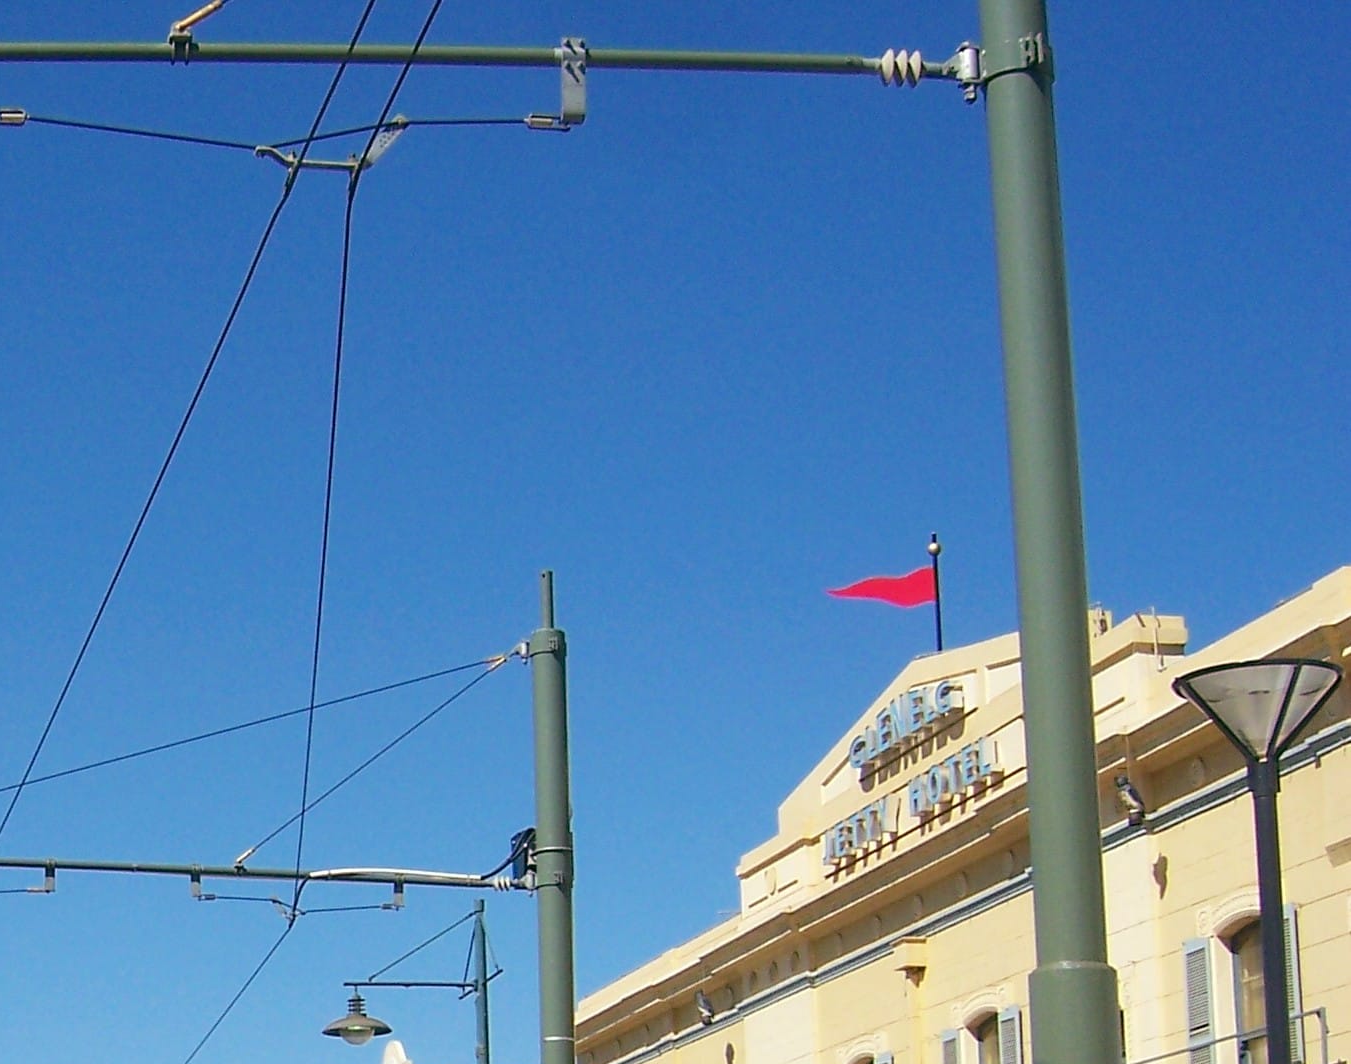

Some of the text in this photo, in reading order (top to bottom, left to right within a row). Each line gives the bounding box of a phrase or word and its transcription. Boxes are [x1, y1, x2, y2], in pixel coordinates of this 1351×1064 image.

[849, 680, 963, 768] GLENELG
[823, 736, 996, 865] JETTY HOTEL
